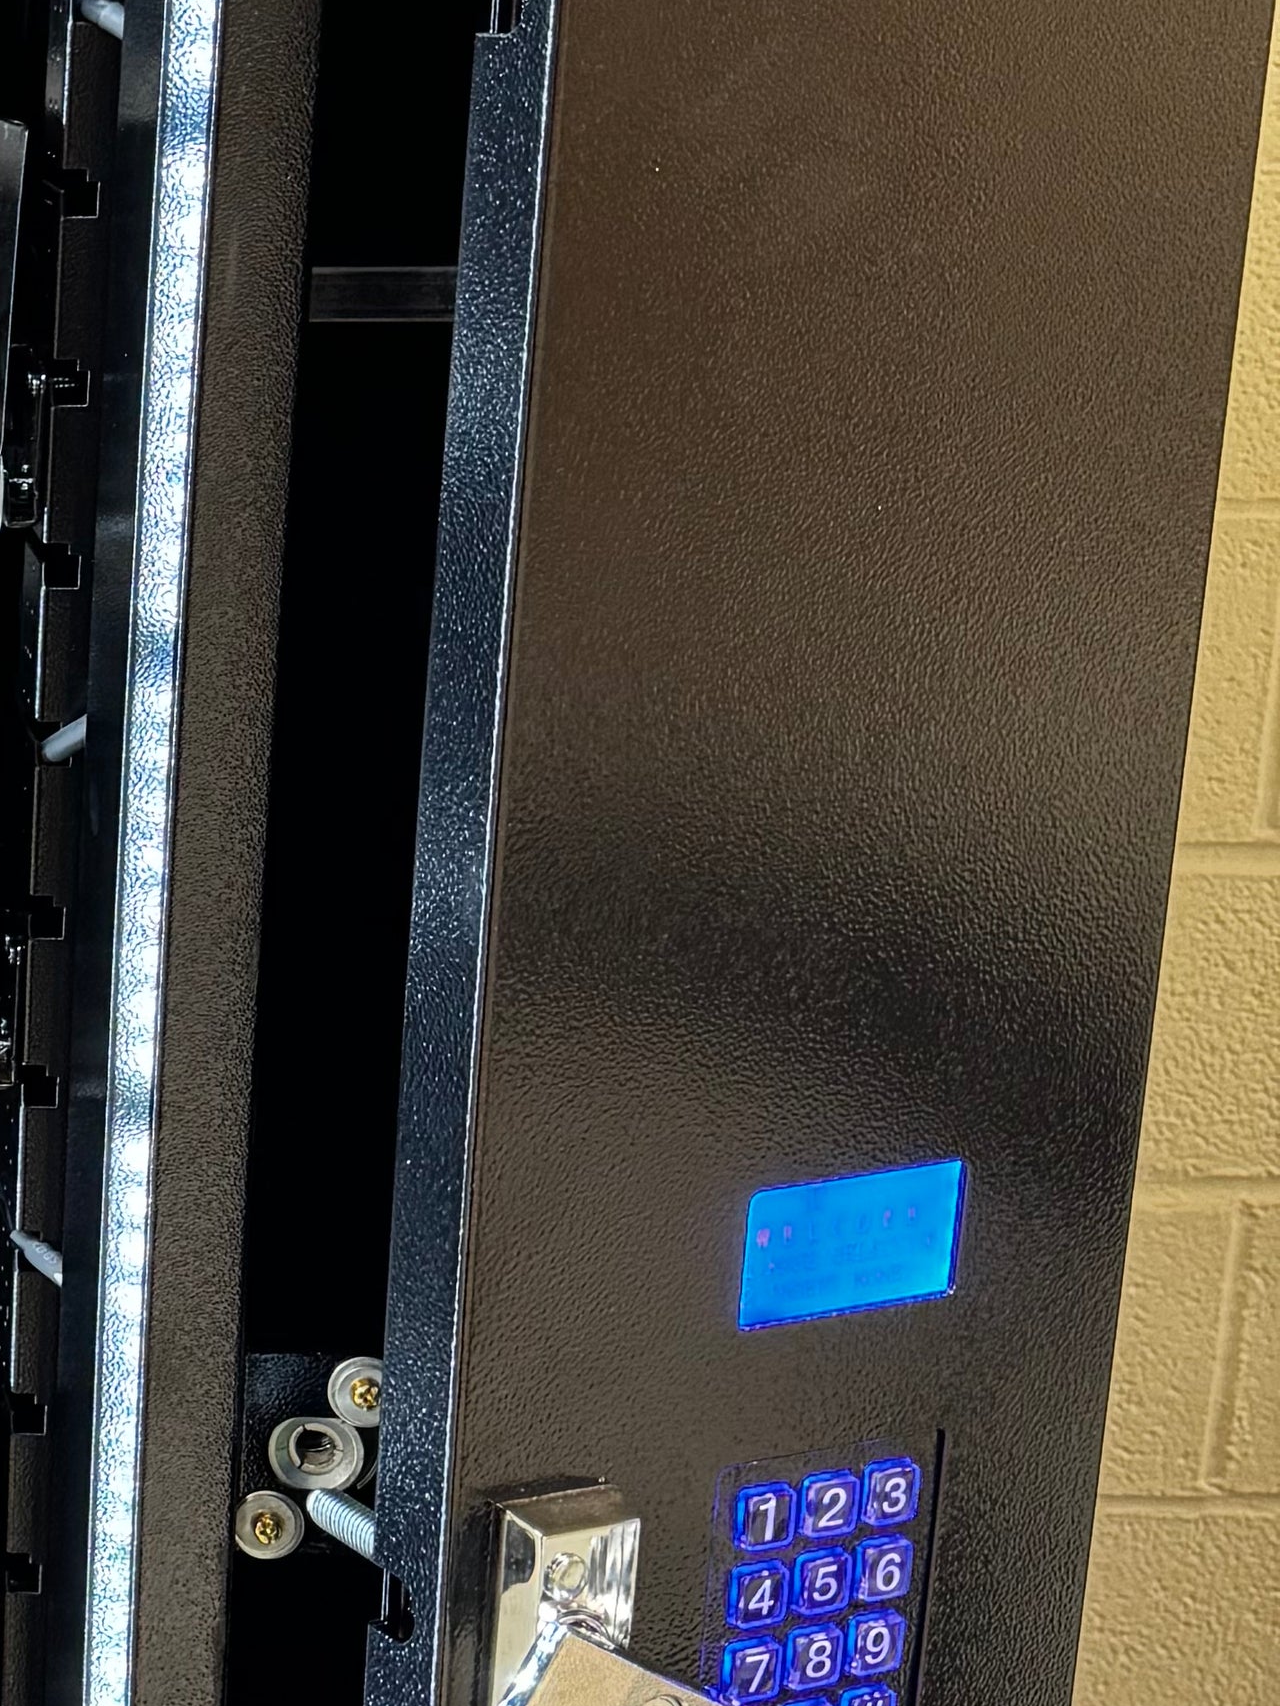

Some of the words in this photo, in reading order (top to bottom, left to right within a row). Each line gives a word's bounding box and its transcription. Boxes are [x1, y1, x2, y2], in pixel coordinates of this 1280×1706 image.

[759, 1495, 777, 1542] 1
[817, 1487, 847, 1528] 2
[882, 1477, 907, 1513] 3
[748, 1579, 774, 1615] 4
[813, 1564, 838, 1601] 5
[876, 1552, 901, 1591] 6
[745, 1653, 770, 1693] 7
[806, 1640, 831, 1678] 8
[865, 1627, 890, 1664] 9
